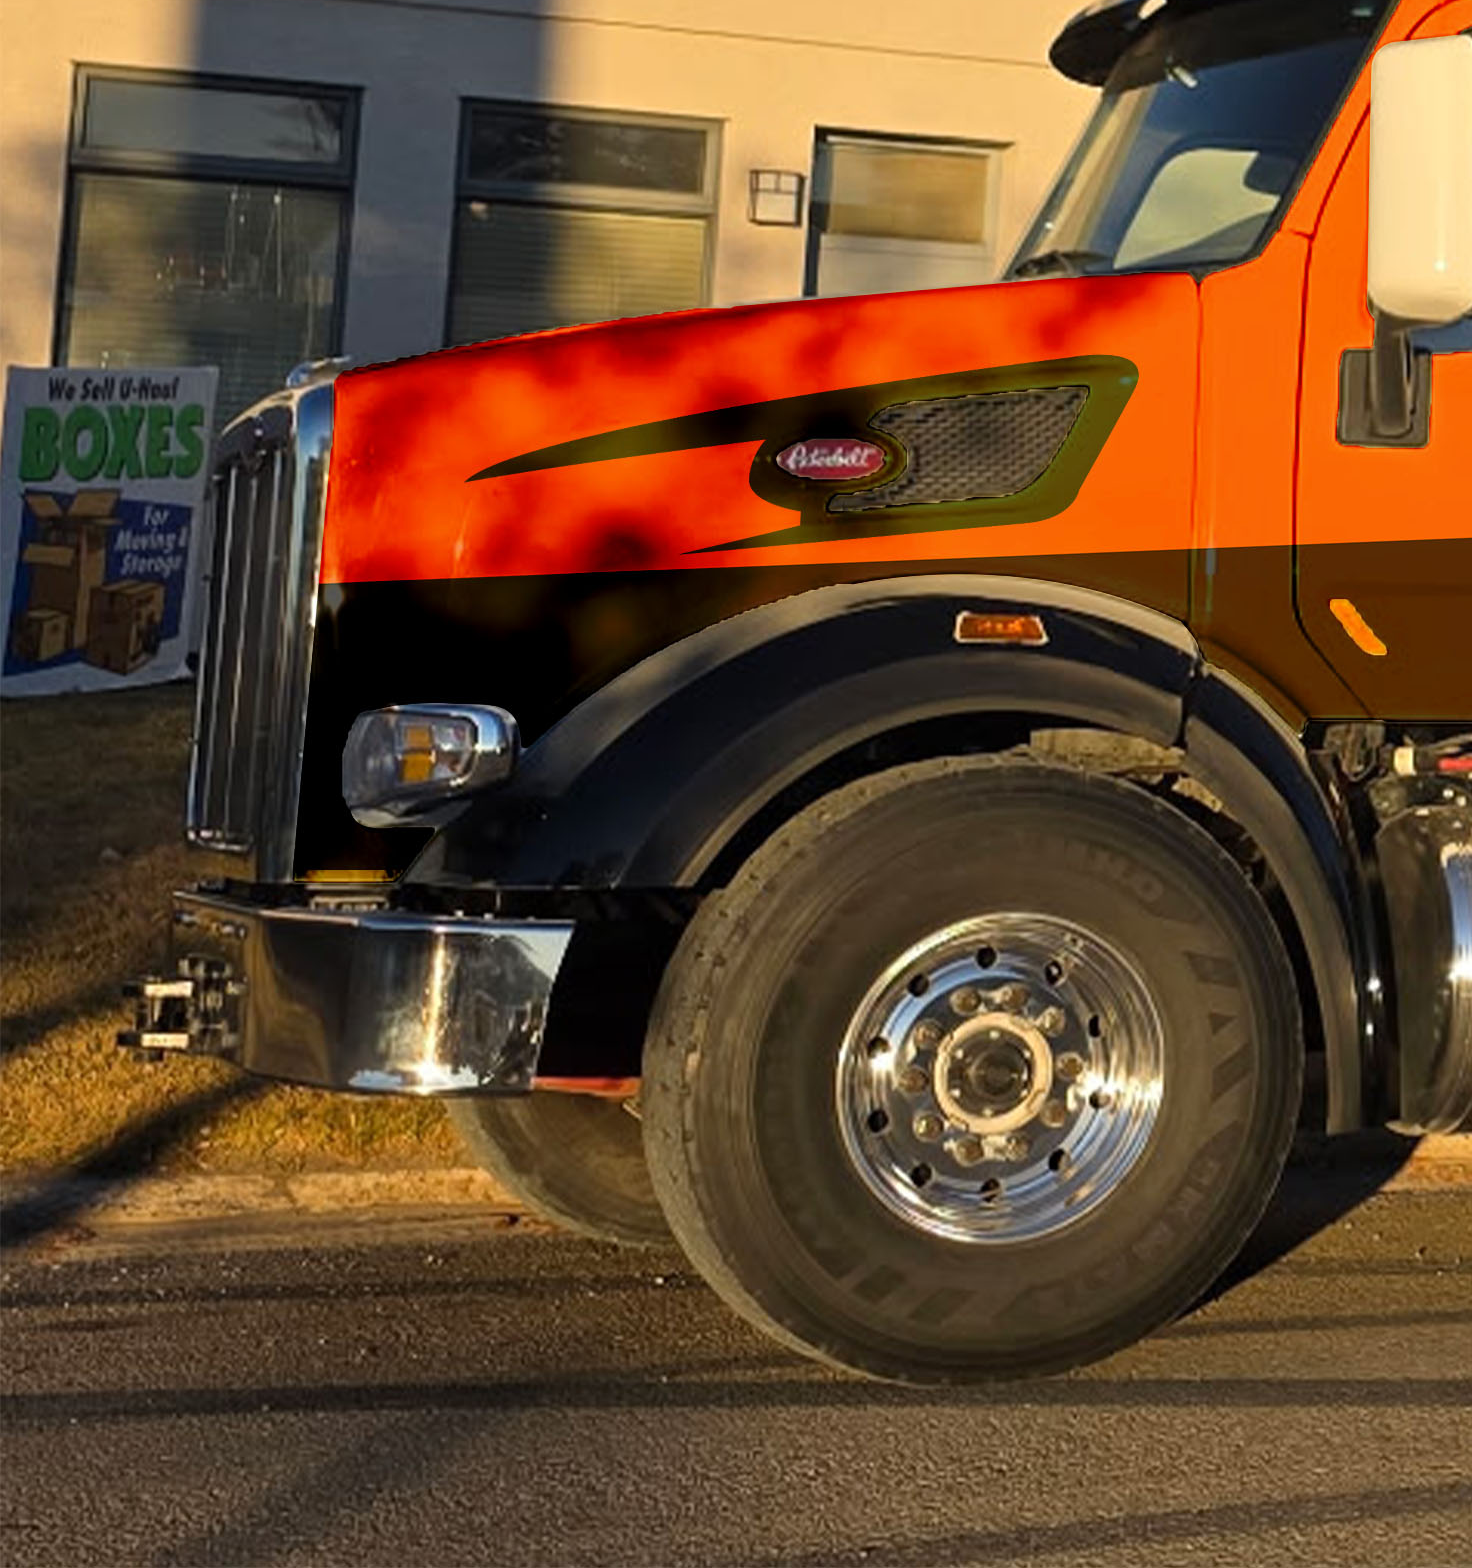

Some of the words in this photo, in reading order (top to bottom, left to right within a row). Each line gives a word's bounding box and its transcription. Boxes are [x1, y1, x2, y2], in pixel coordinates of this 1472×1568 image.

[48, 376, 77, 402] We
[80, 377, 115, 402] Sell
[19, 403, 205, 482] BOXES
[144, 506, 169, 527] For
[114, 529, 177, 555] Moving
[121, 551, 184, 578] Storage
